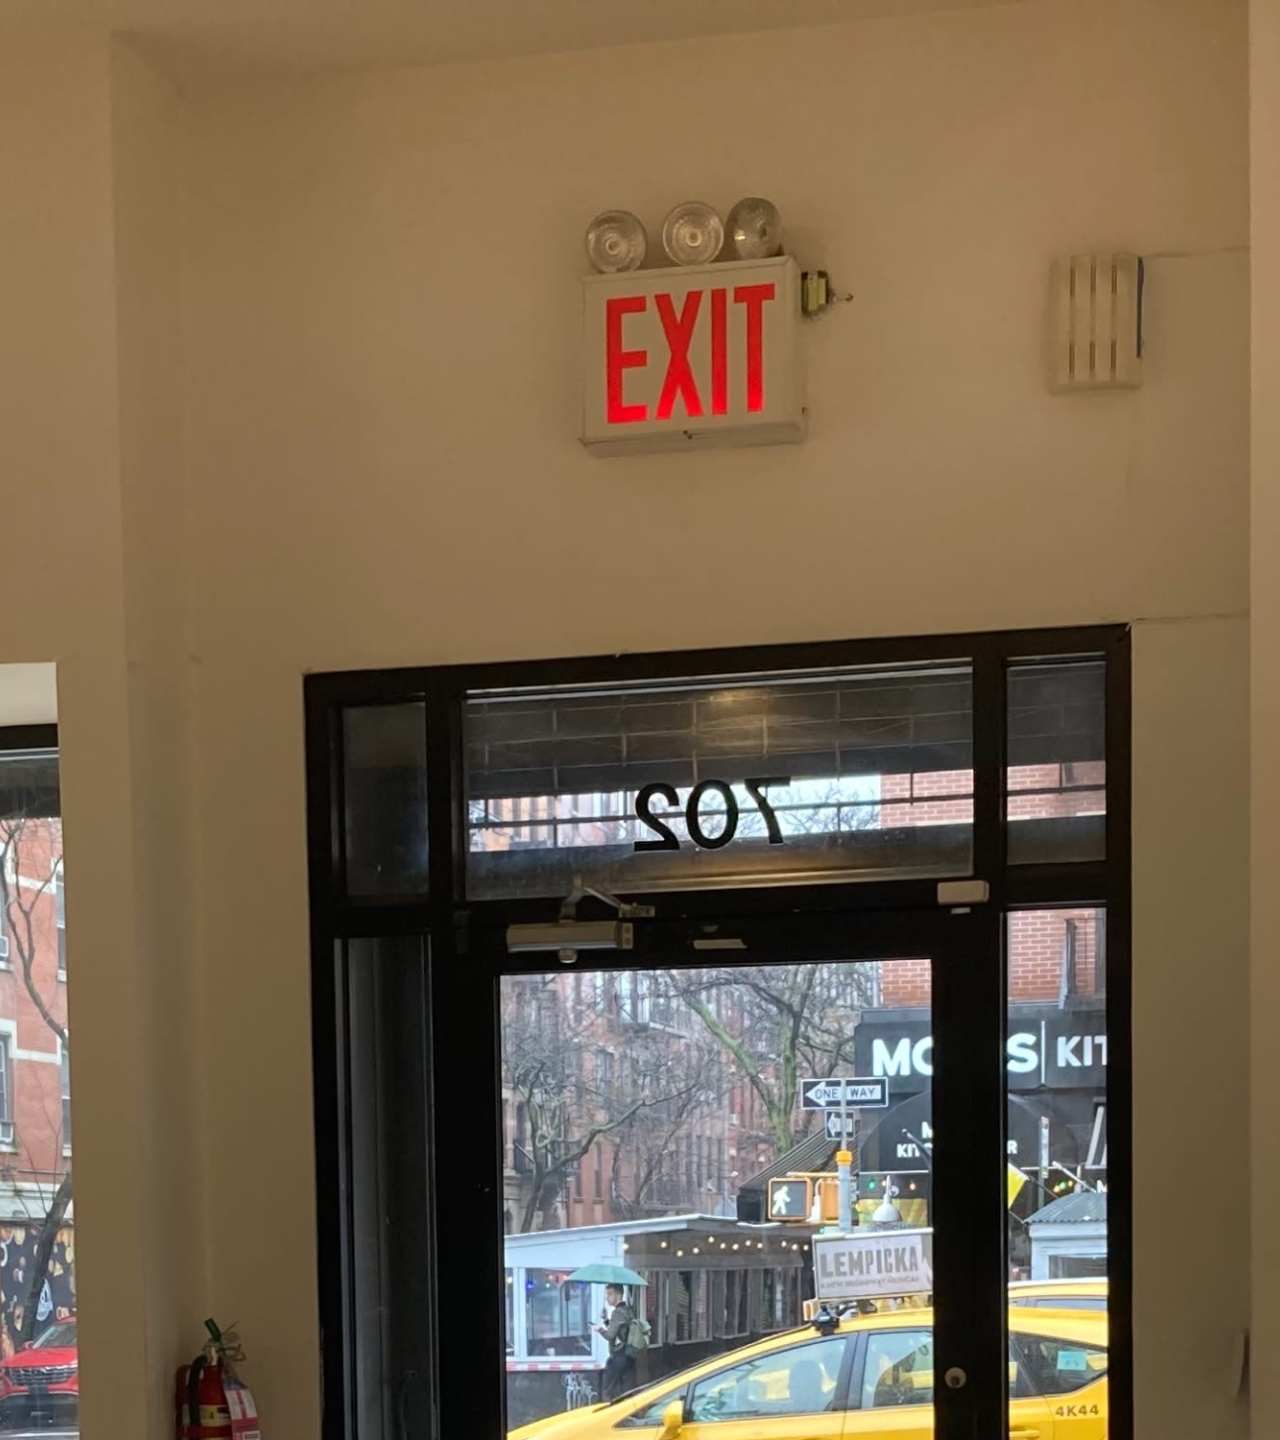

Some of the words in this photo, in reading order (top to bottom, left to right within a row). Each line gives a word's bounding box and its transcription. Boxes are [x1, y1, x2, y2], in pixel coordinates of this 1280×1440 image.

[606, 283, 776, 424] EXIT
[815, 1086, 839, 1100] ONE
[850, 1085, 876, 1099] WAY
[820, 1246, 919, 1278] LEMPICKA
[1055, 1404, 1099, 1417] 4K44
